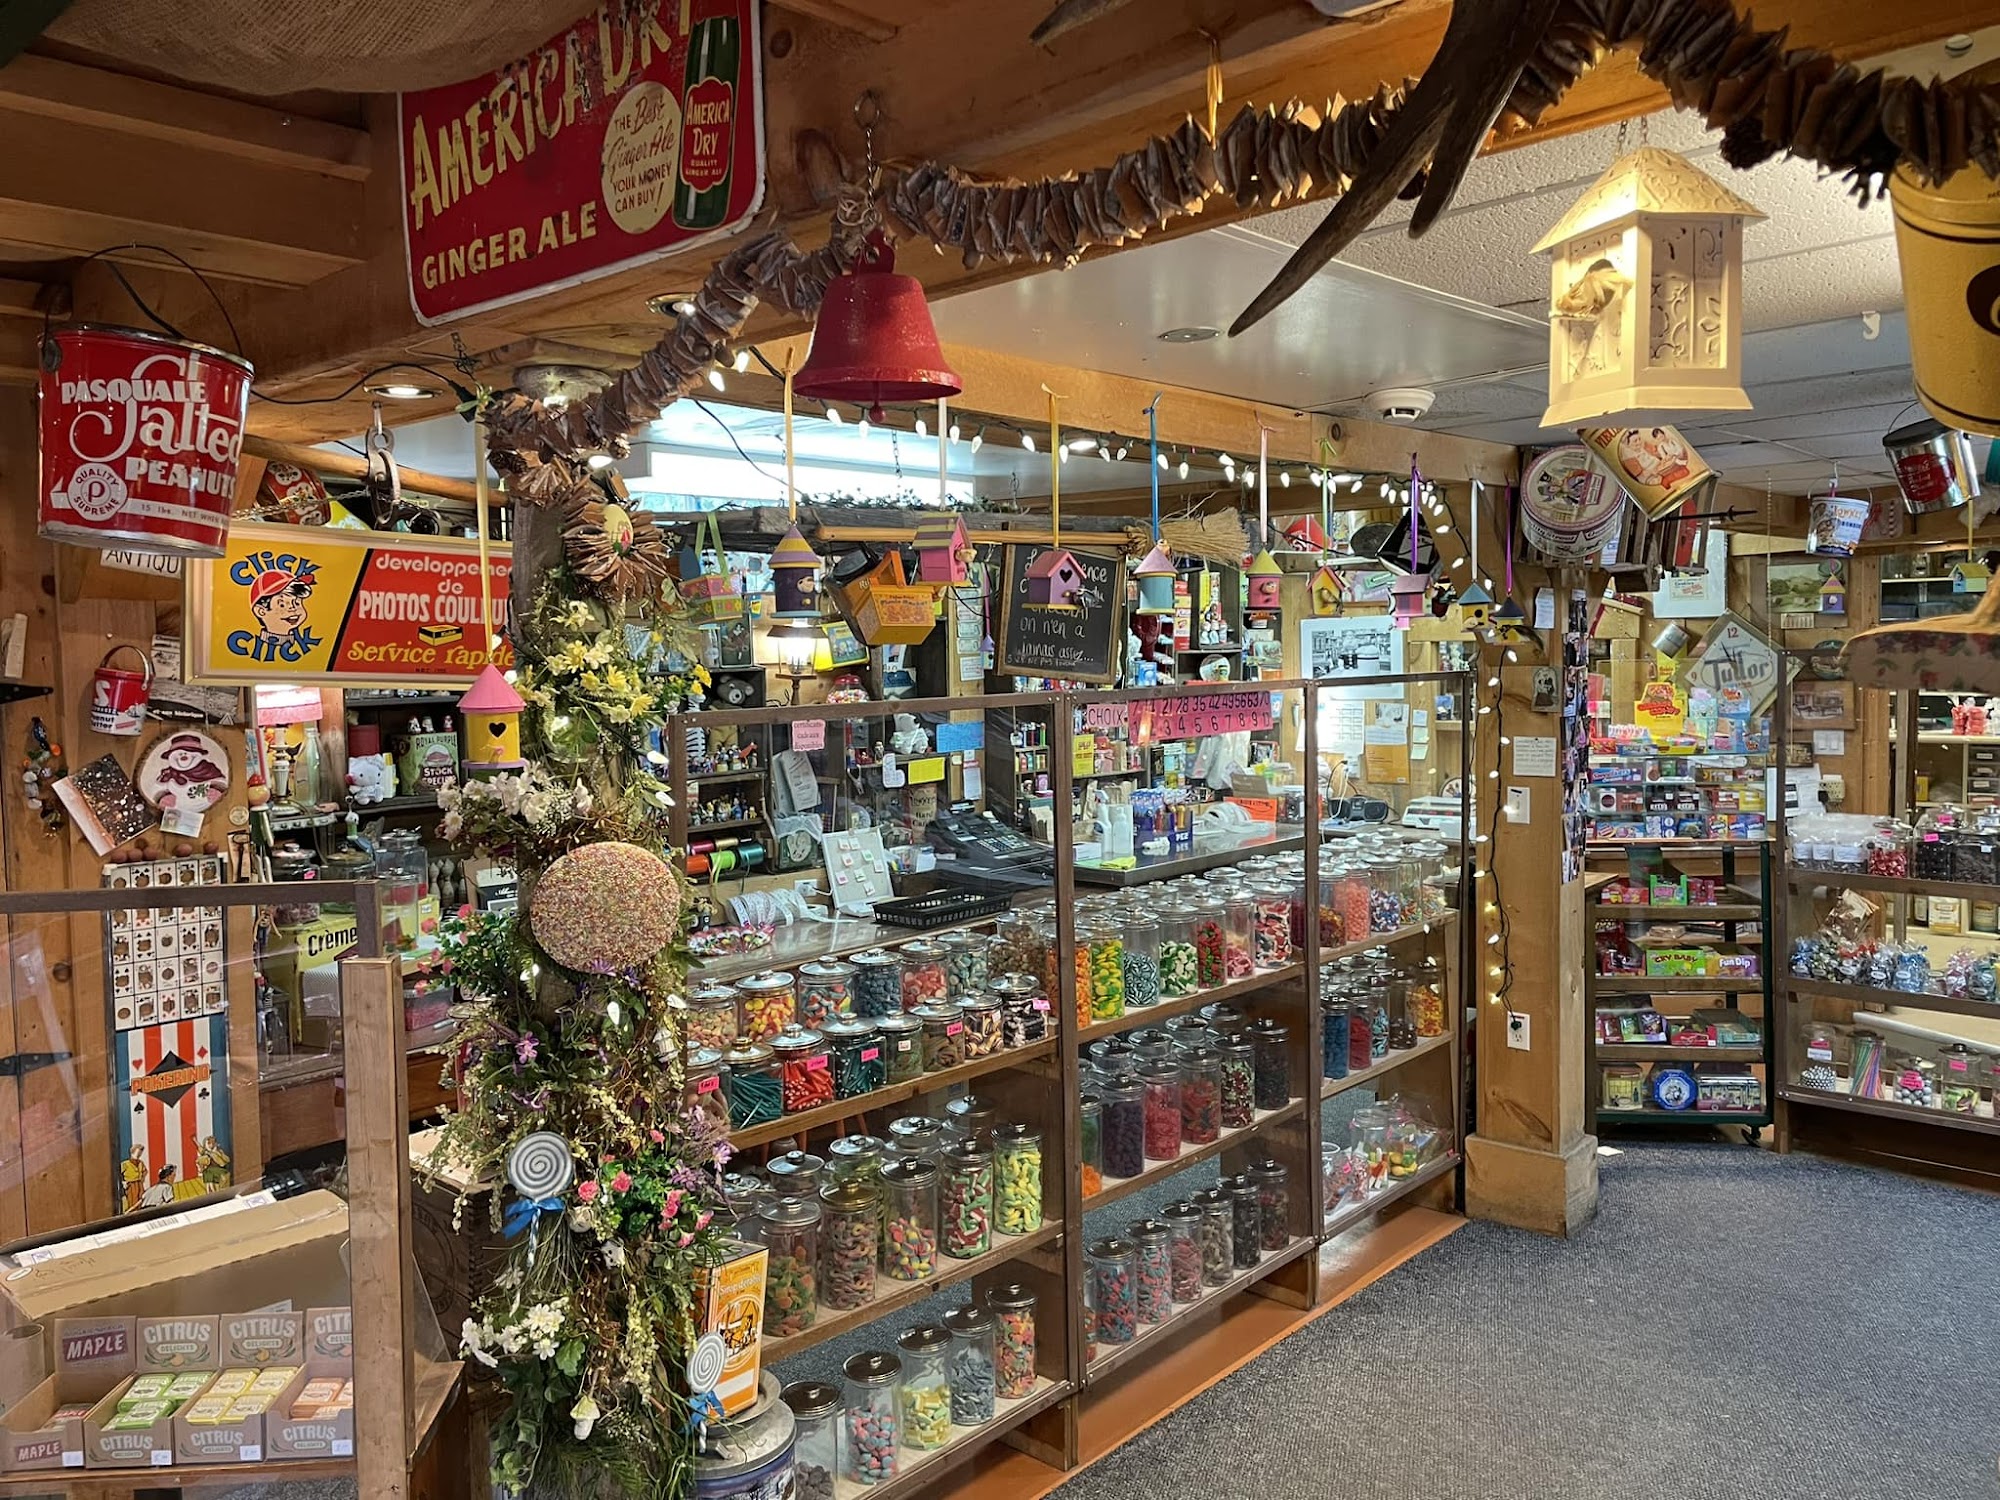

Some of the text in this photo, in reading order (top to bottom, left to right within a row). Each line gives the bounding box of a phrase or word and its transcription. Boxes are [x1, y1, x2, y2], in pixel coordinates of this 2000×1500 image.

[614, 94, 666, 136] THE Best
[686, 96, 730, 126] AMERICA
[410, 29, 594, 232] AMERICA
[607, 119, 675, 183] Ginger Ale
[693, 128, 719, 156] DRY
[612, 162, 673, 195] YOUR MONEY
[615, 193, 635, 214] CAN
[421, 201, 598, 291] GINGER ALE
[61, 378, 207, 404] PASQUALE
[75, 468, 120, 487] QUALITY
[73, 497, 120, 516] SUPREME
[437, 579, 464, 594] de
[359, 590, 430, 623] PHOTOS
[1020, 617, 1036, 634] on
[1074, 624, 1086, 638] a
[1727, 627, 1739, 639] 12
[347, 641, 436, 666] Service
[1088, 708, 1125, 726] CHOIX
[1163, 718, 1171, 735] 3
[1178, 716, 1186, 733] 4
[1194, 717, 1202, 733] 5
[1211, 715, 1219, 731] 6
[1224, 714, 1232, 730] 7
[1238, 712, 1245, 727] 8
[1251, 711, 1258, 727] 9
[423, 766, 453, 777] STOCK
[1175, 832, 1189, 842] PEZ
[308, 928, 358, 957] Crème
[1654, 953, 1699, 964] CRY BABY
[1719, 957, 1752, 969] Fun Dip
[131, 1063, 210, 1096] POKERINO
[144, 1321, 212, 1344] CITRUS
[229, 1318, 297, 1339] CITRUS
[66, 1333, 125, 1361] MAPLE
[100, 1435, 154, 1450] CITRUS
[190, 1430, 244, 1446] CITRUS
[283, 1425, 337, 1442] CITRUS
[18, 1442, 60, 1462] MAPLE
